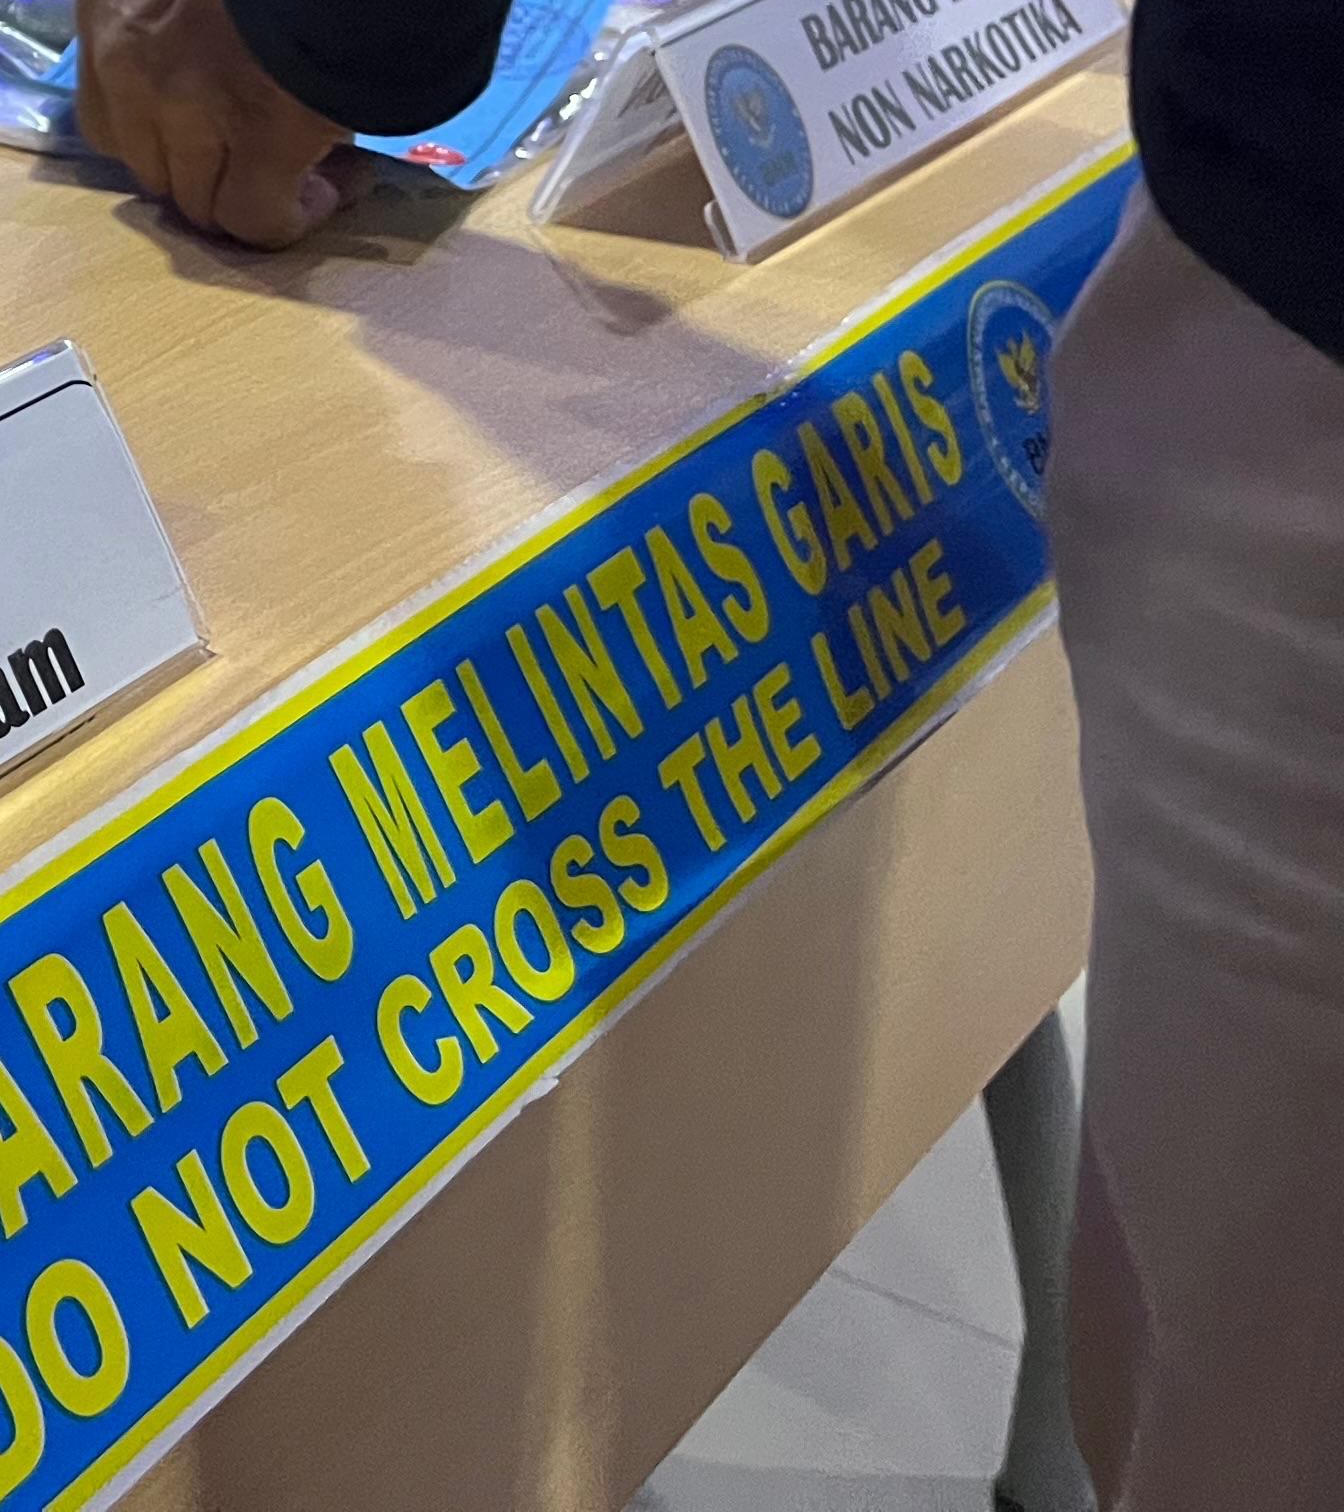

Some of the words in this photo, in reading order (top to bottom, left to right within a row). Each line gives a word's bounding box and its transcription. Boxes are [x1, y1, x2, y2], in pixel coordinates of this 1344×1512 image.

[827, 85, 917, 166] NON
[329, 487, 773, 920] MELINTAS
[753, 346, 966, 616] GARIS
[129, 1040, 374, 1329] NOT
[374, 797, 674, 1107] CROSS
[657, 658, 822, 866] THE
[816, 533, 968, 744] LINE
